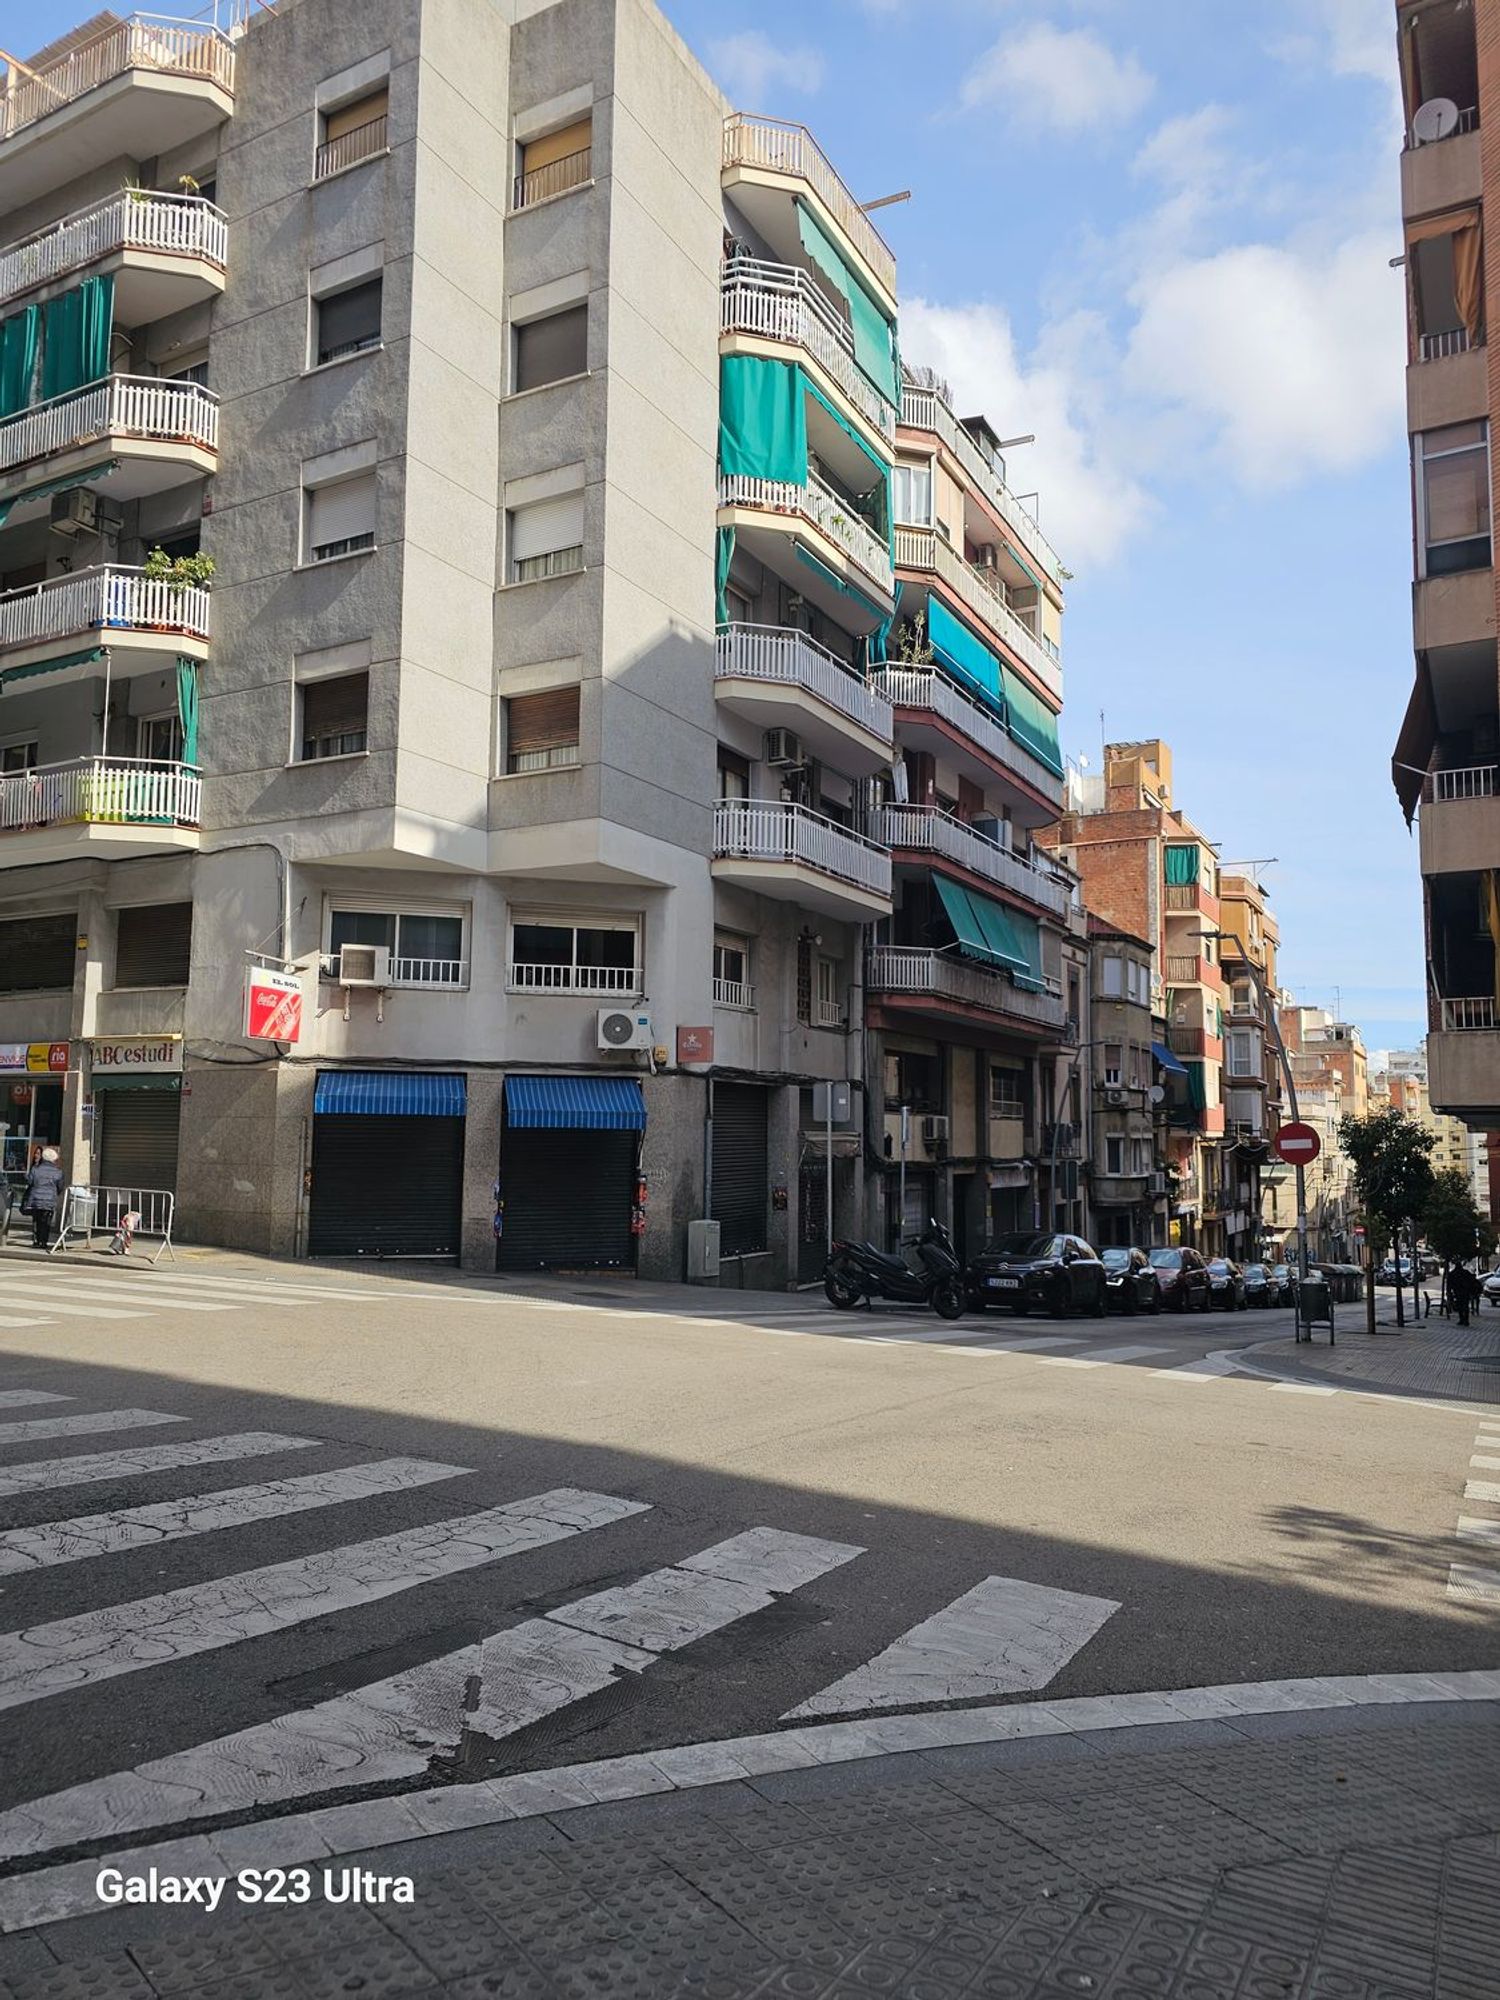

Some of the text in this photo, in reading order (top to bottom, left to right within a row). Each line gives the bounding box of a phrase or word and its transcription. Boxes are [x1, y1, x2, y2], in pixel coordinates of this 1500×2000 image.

[272, 978, 300, 990] EL SOL
[93, 1043, 174, 1066] ABCestudi
